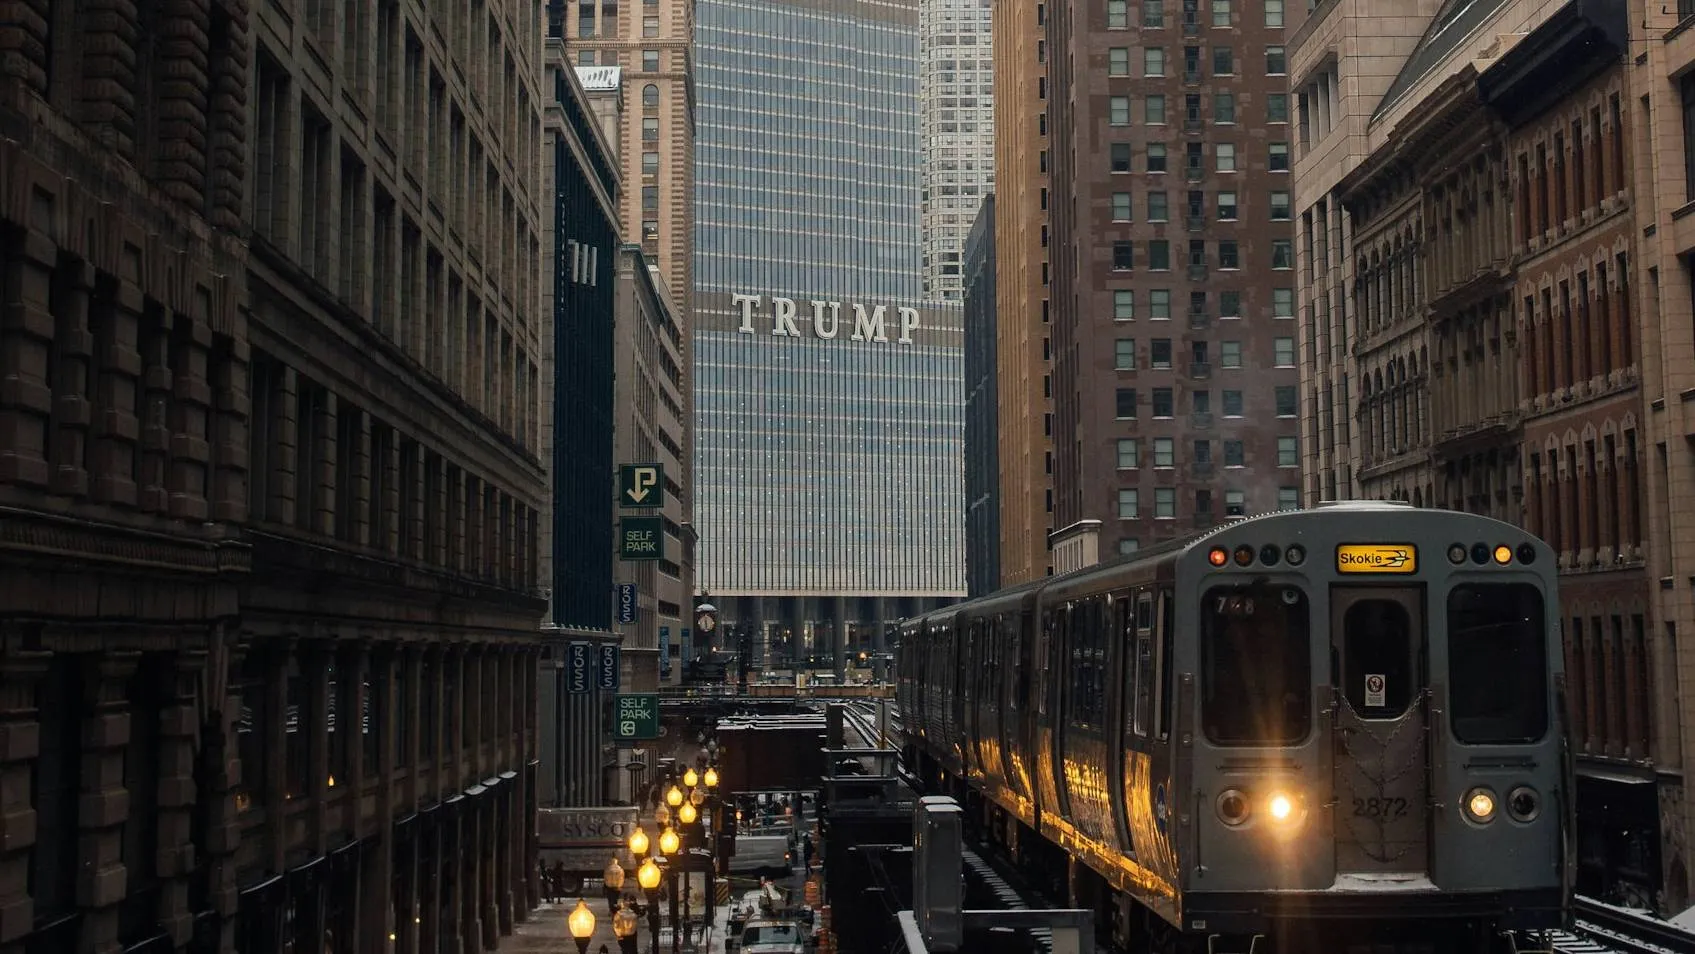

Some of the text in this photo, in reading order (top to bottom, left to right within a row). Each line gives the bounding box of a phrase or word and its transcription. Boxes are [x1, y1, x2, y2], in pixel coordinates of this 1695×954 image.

[732, 292, 920, 344] TRUMP
[626, 531, 653, 541] SELF
[626, 541, 656, 552] PARK
[1340, 553, 1382, 564] Skokie
[622, 585, 631, 622] ROSS
[573, 646, 585, 690] ROSS
[603, 646, 614, 687] ROSS
[620, 698, 647, 708] SELF
[620, 709, 651, 720] PARK
[1352, 797, 1407, 816] 2872
[563, 823, 625, 837] SYSCO
